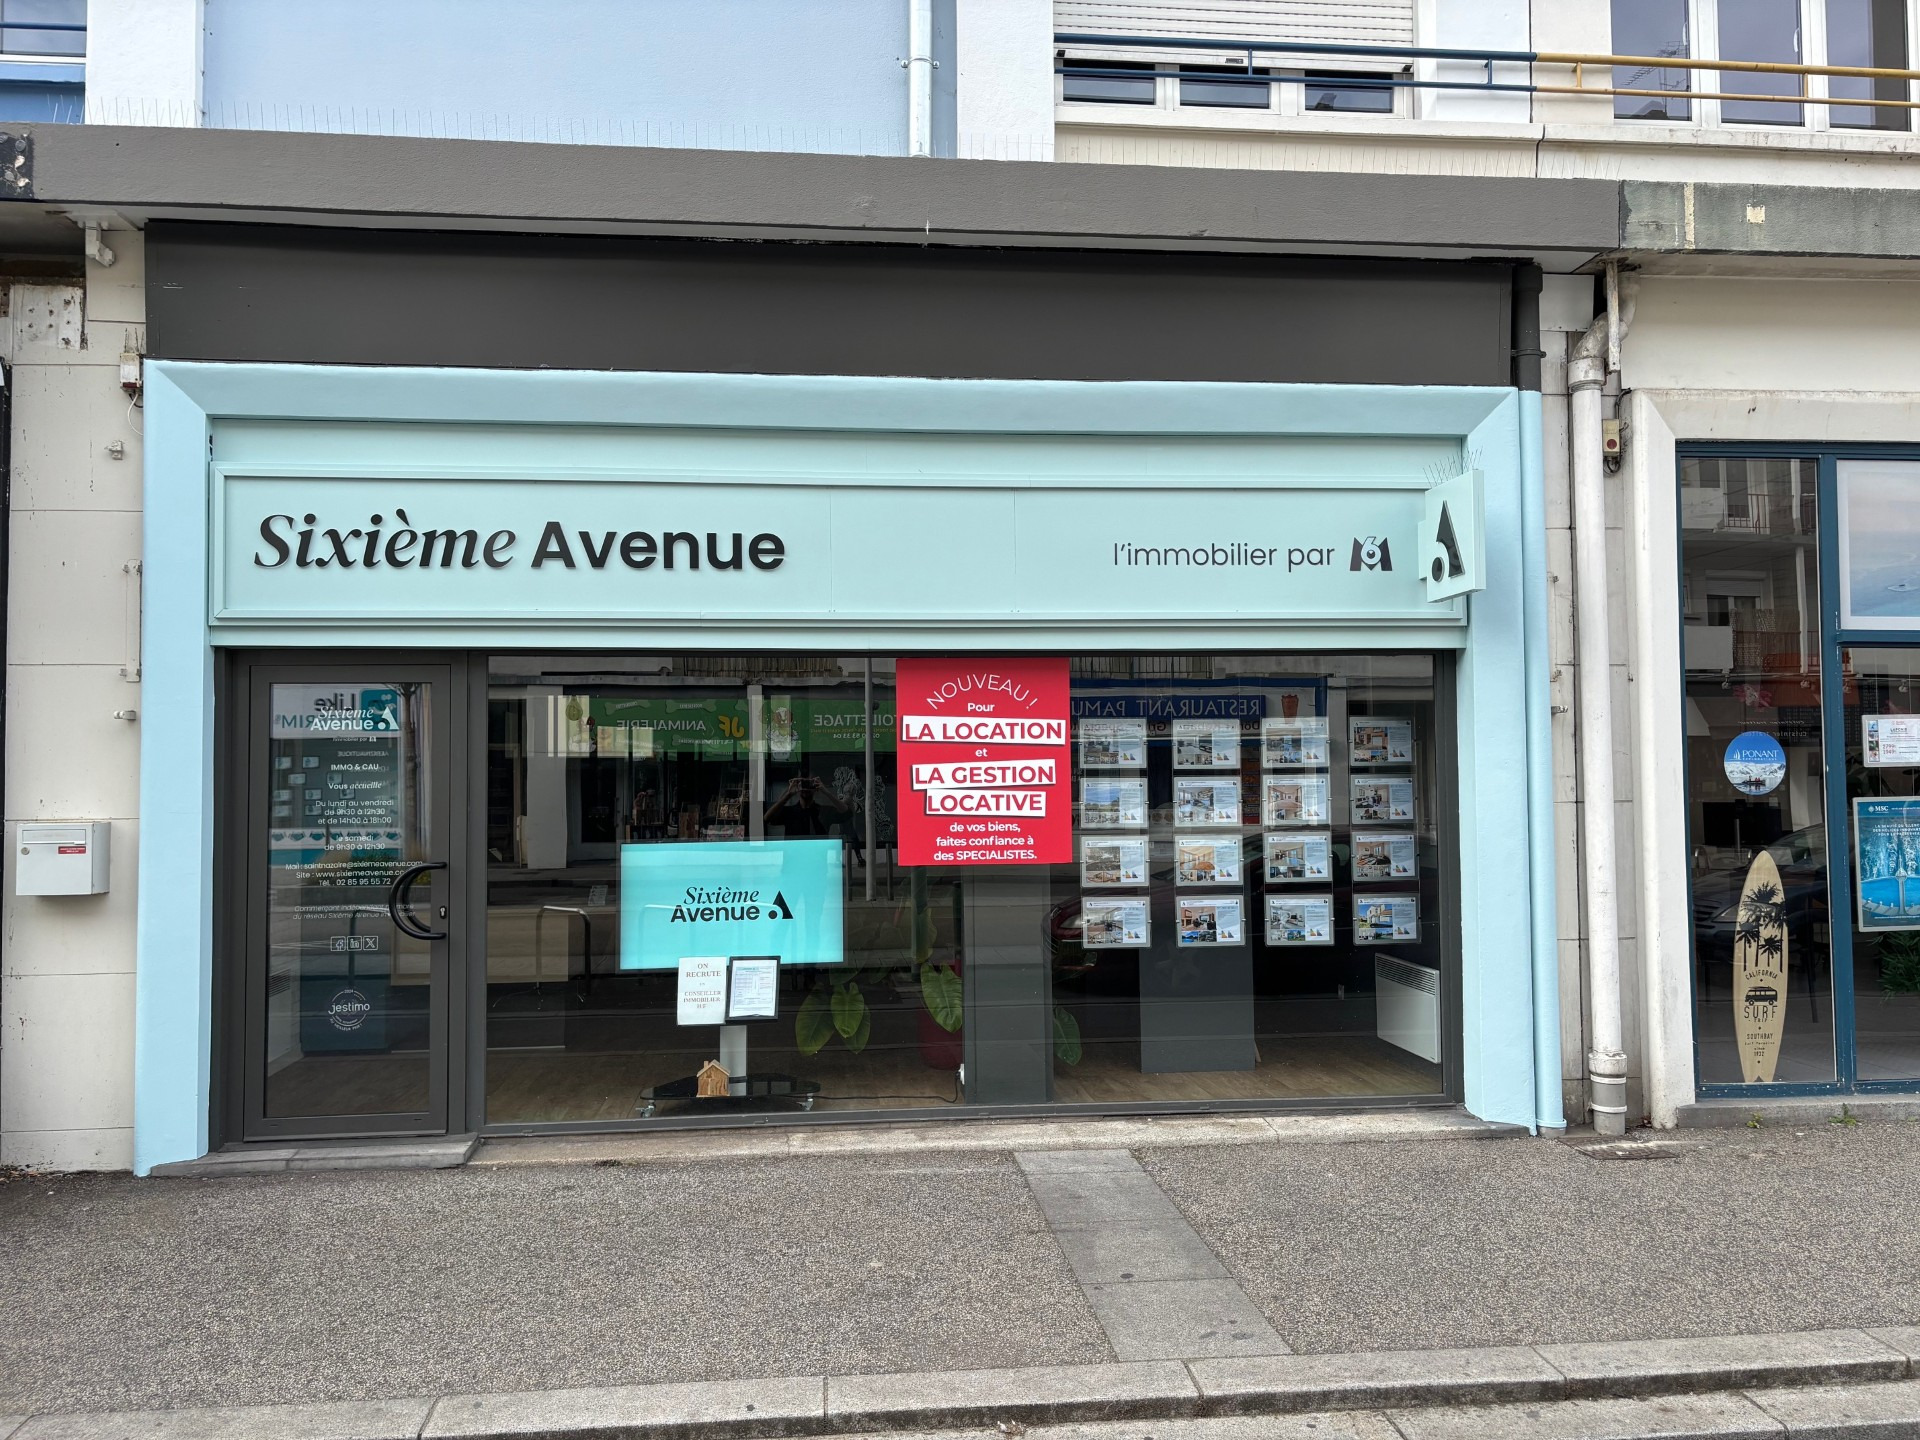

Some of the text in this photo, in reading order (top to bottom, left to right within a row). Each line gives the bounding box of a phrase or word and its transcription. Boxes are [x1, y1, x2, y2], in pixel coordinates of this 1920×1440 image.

[254, 508, 785, 570] Sixième Avenue
[1288, 547, 1336, 573] par
[967, 702, 995, 712] Pour
[310, 718, 374, 731] Avenue
[904, 722, 1062, 740] LA LOCATION
[975, 748, 988, 757] et
[1742, 749, 1779, 758] PONANT
[914, 765, 1054, 785] LA GESTION
[927, 793, 1043, 812] LOCATIVE
[950, 821, 1021, 832] de vos biens,
[345, 833, 374, 841] samedi
[936, 835, 1034, 846] faites confiance à
[934, 850, 1037, 860] des SPECIALISTES.
[683, 886, 759, 905] Sixième
[670, 904, 760, 923] Avenue
[1745, 969, 1778, 980] CALIFORNIA
[328, 1002, 370, 1015] jestimo
[1744, 1005, 1778, 1018] SURF
